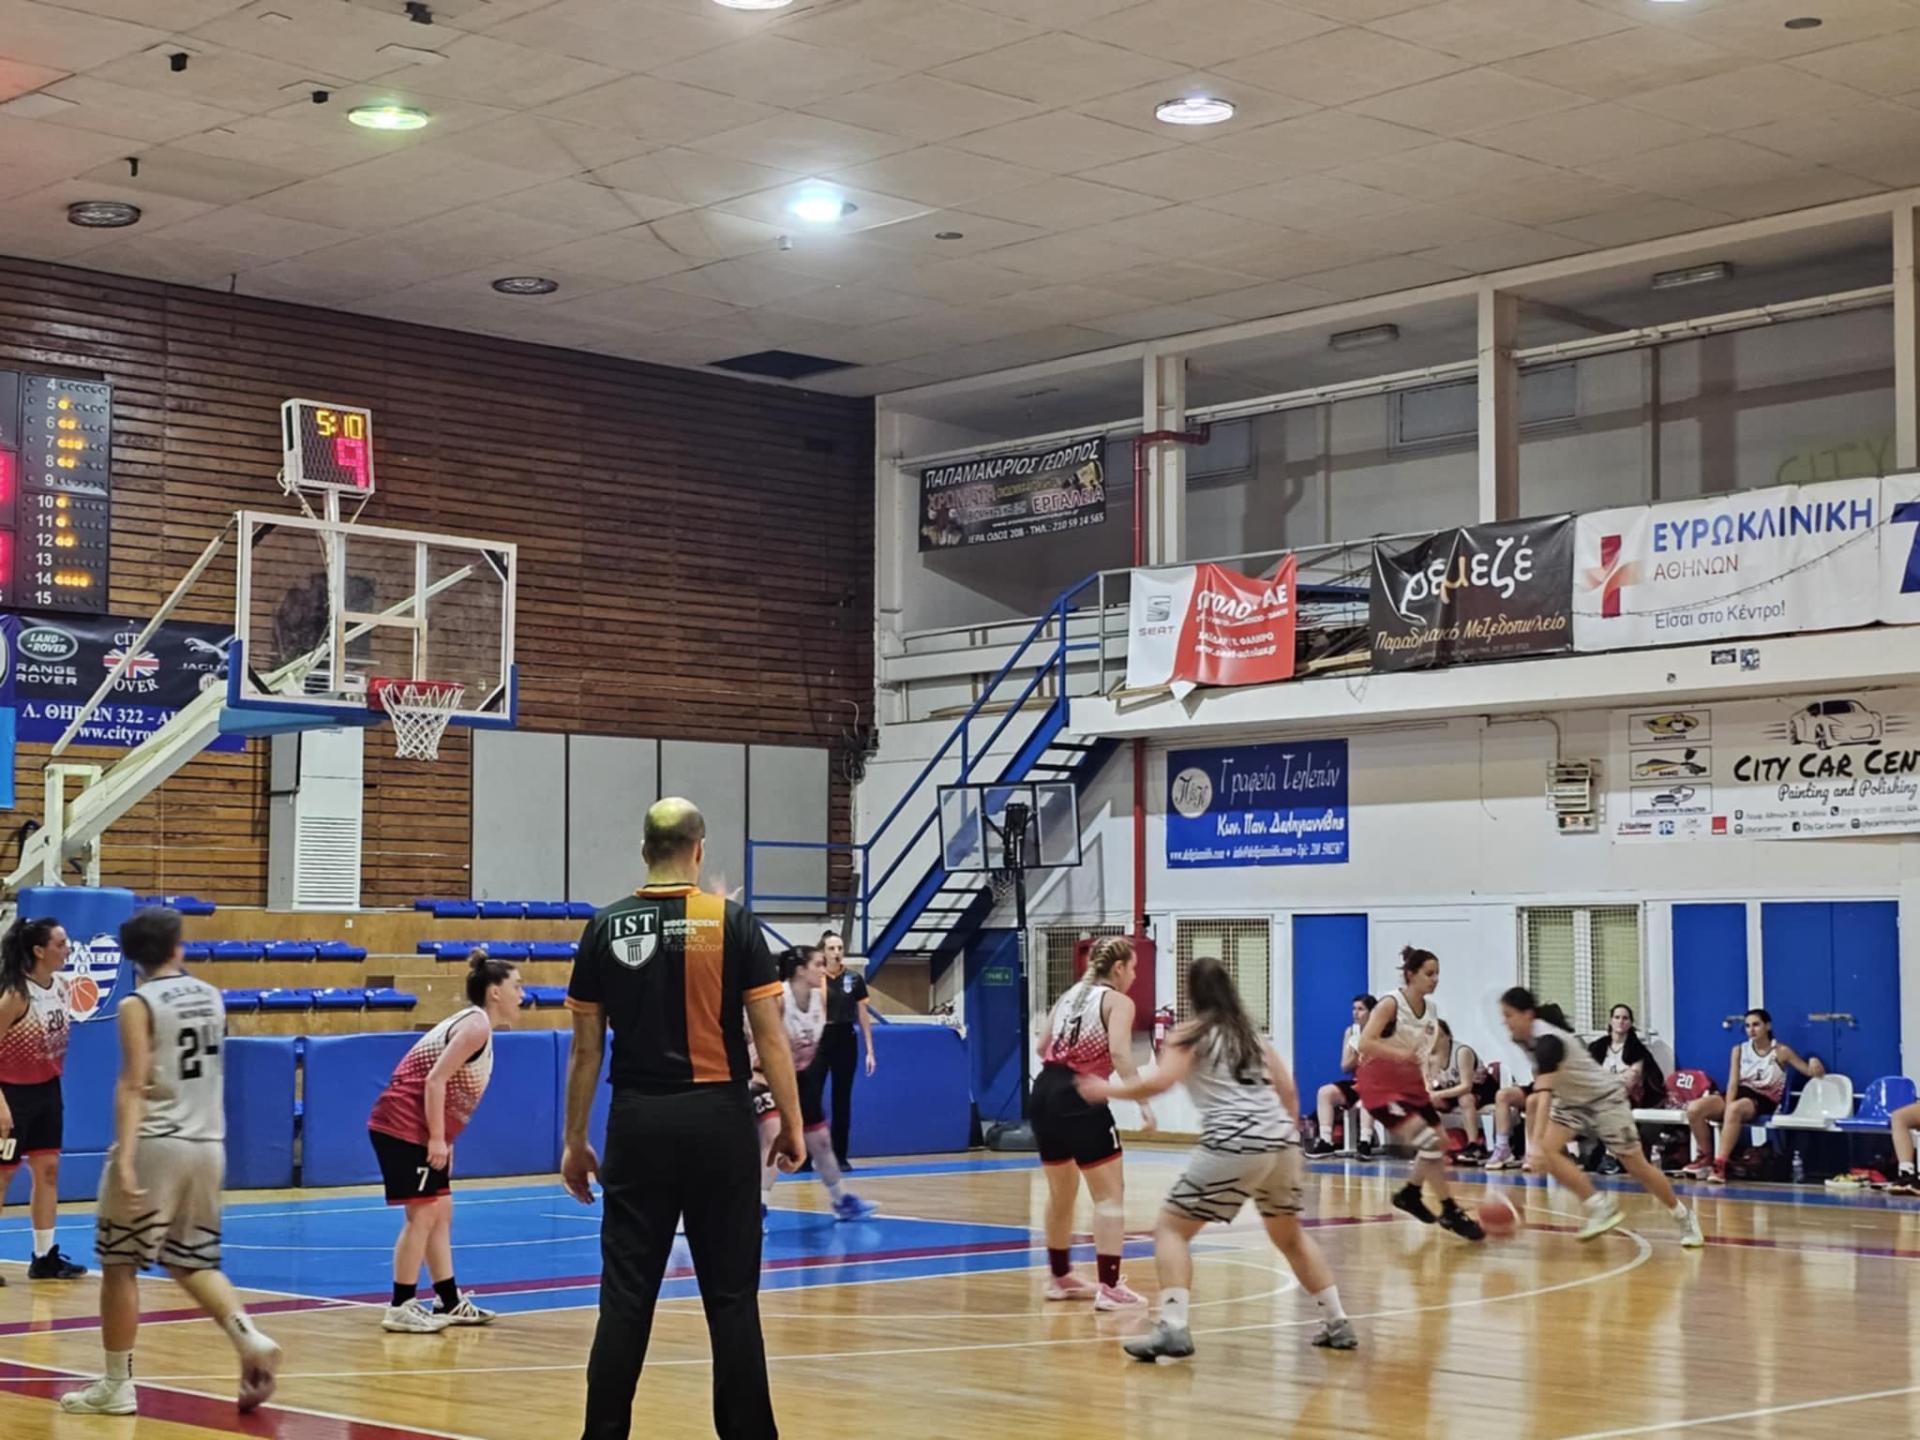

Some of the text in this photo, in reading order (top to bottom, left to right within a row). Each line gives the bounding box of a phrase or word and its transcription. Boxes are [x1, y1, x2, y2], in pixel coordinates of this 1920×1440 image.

[46, 378, 56, 391] 4
[46, 397, 56, 410] 5
[46, 416, 55, 429] 6
[315, 409, 363, 439] 5:10
[45, 435, 54, 448] 7
[45, 454, 54, 467] 8
[337, 438, 366, 489] 9
[44, 474, 53, 486] 9
[38, 495, 54, 508] 10
[36, 514, 52, 527] 11
[1653, 497, 1873, 553] ΕΥΡΩΚΛΙΝΙΚΗ
[36, 533, 53, 547] 12
[36, 552, 52, 566] 13
[1653, 554, 1739, 581] ΑΘΗΝΩΝ
[35, 571, 52, 585] 14
[34, 591, 52, 604] 15
[1700, 613, 1723, 626] στο
[1727, 600, 1786, 624] Κέντρο!
[16, 663, 77, 675] RANGE
[16, 673, 78, 686] ROVER
[107, 678, 159, 693] OVER
[116, 708, 144, 724] 322
[1733, 755, 1791, 782] CITY
[1799, 753, 1853, 779] CAR
[1778, 776, 1919, 806] Painting and Polishing
[613, 913, 655, 938] IST
[1676, 1073, 1695, 1089] 20
[416, 1166, 430, 1192] 7
